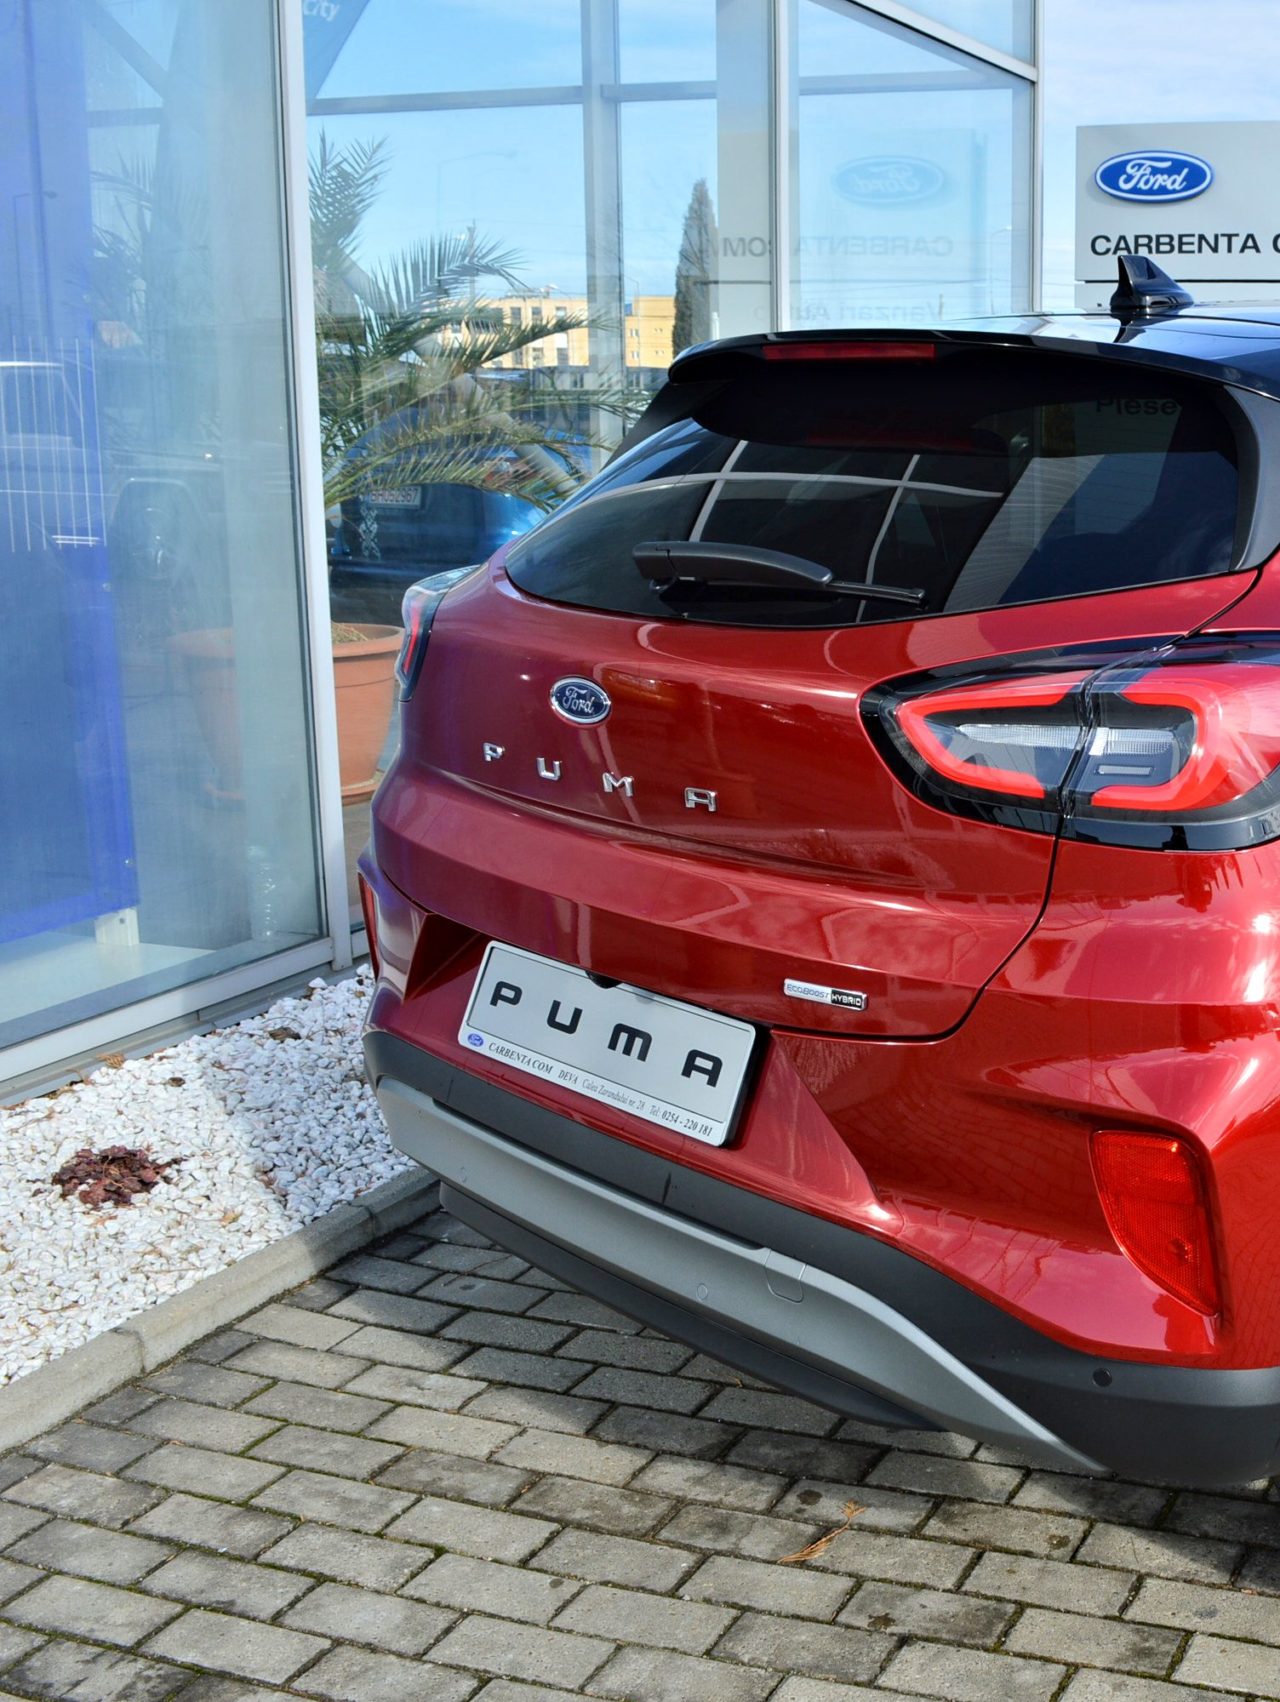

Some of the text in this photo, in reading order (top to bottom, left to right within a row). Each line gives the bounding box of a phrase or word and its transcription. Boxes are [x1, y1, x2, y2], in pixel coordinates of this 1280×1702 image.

[1119, 159, 1188, 190] Ford
[1090, 233, 1261, 256] CARBENTA
[562, 686, 595, 714] Ford
[483, 742, 717, 812] PUMA
[831, 993, 862, 1006] HYBRID
[489, 981, 723, 1088] PUMA
[488, 1042, 533, 1067] CARBENTA
[531, 1059, 554, 1075] COM
[558, 1069, 579, 1085] DEVA
[661, 1109, 680, 1124] 0254
[684, 1118, 698, 1131] 220
